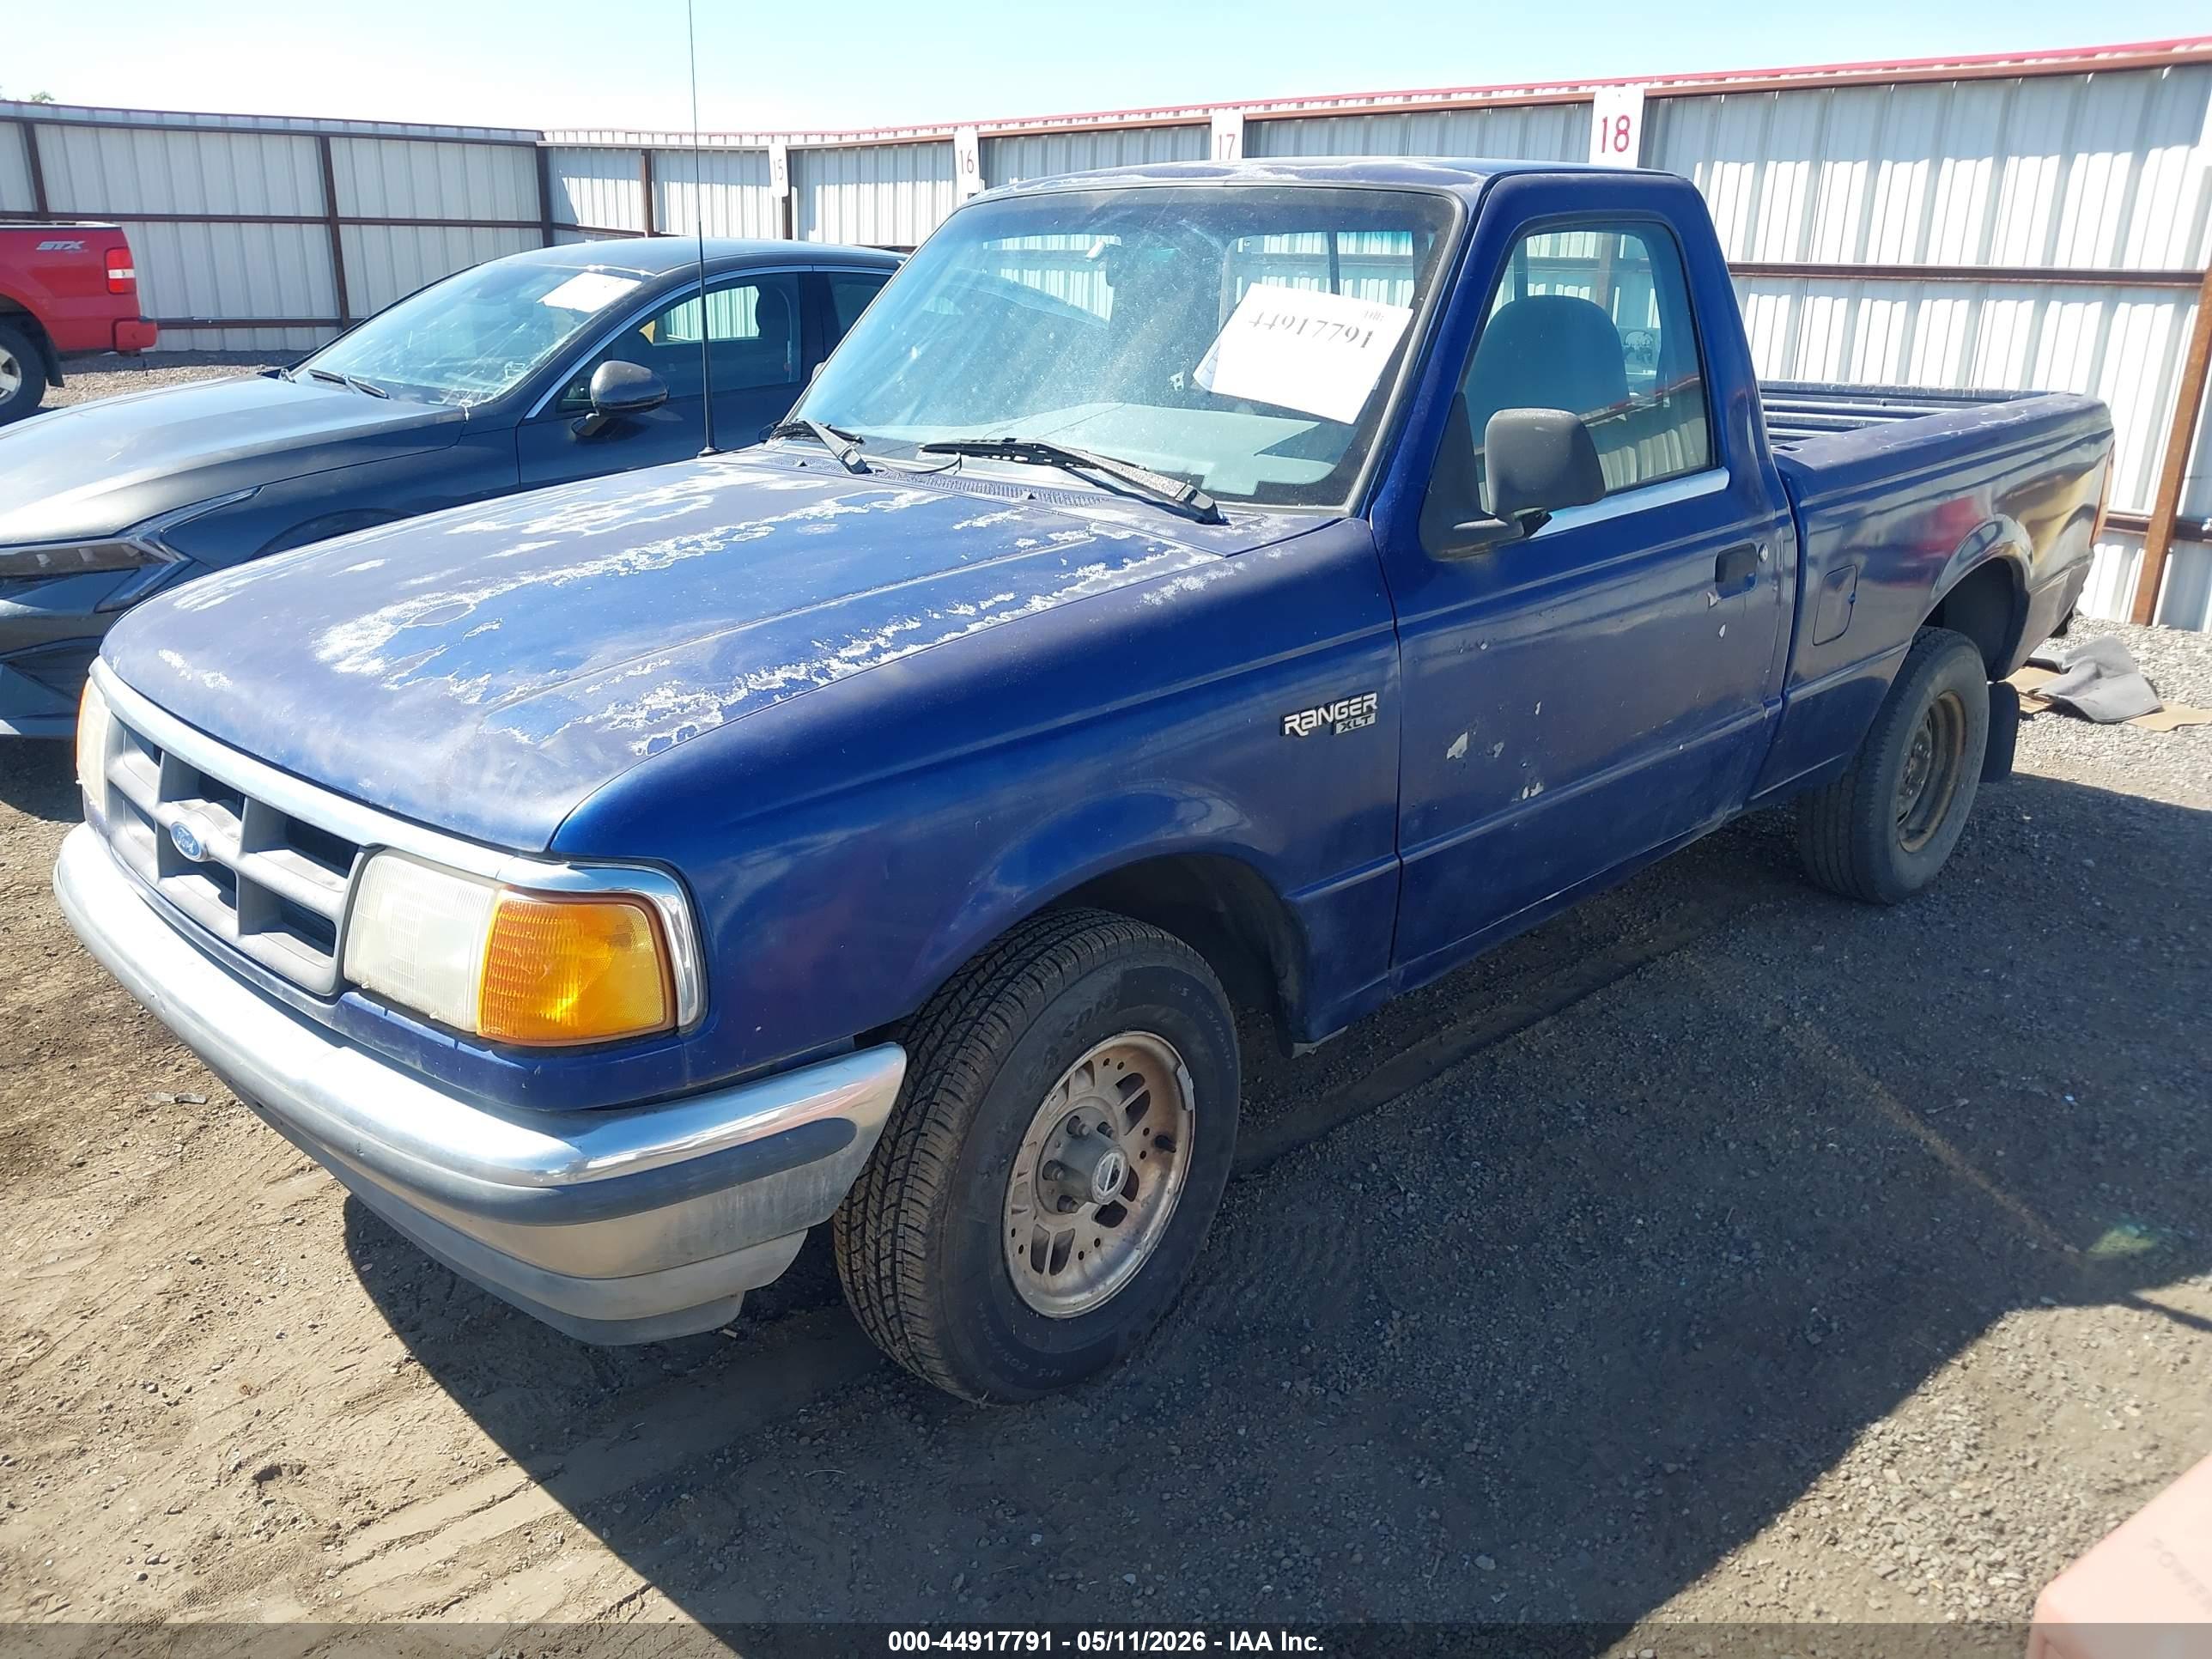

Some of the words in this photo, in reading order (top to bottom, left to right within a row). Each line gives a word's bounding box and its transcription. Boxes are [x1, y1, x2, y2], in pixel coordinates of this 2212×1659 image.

[1218, 133, 1237, 161] 17
[1601, 114, 1631, 154] 18
[773, 158, 784, 181] 15
[959, 149, 975, 175] 16
[36, 240, 85, 251] STX
[1249, 311, 1374, 349] 44917791
[1284, 692, 1377, 737] RANGER
[1339, 714, 1373, 733] XLT
